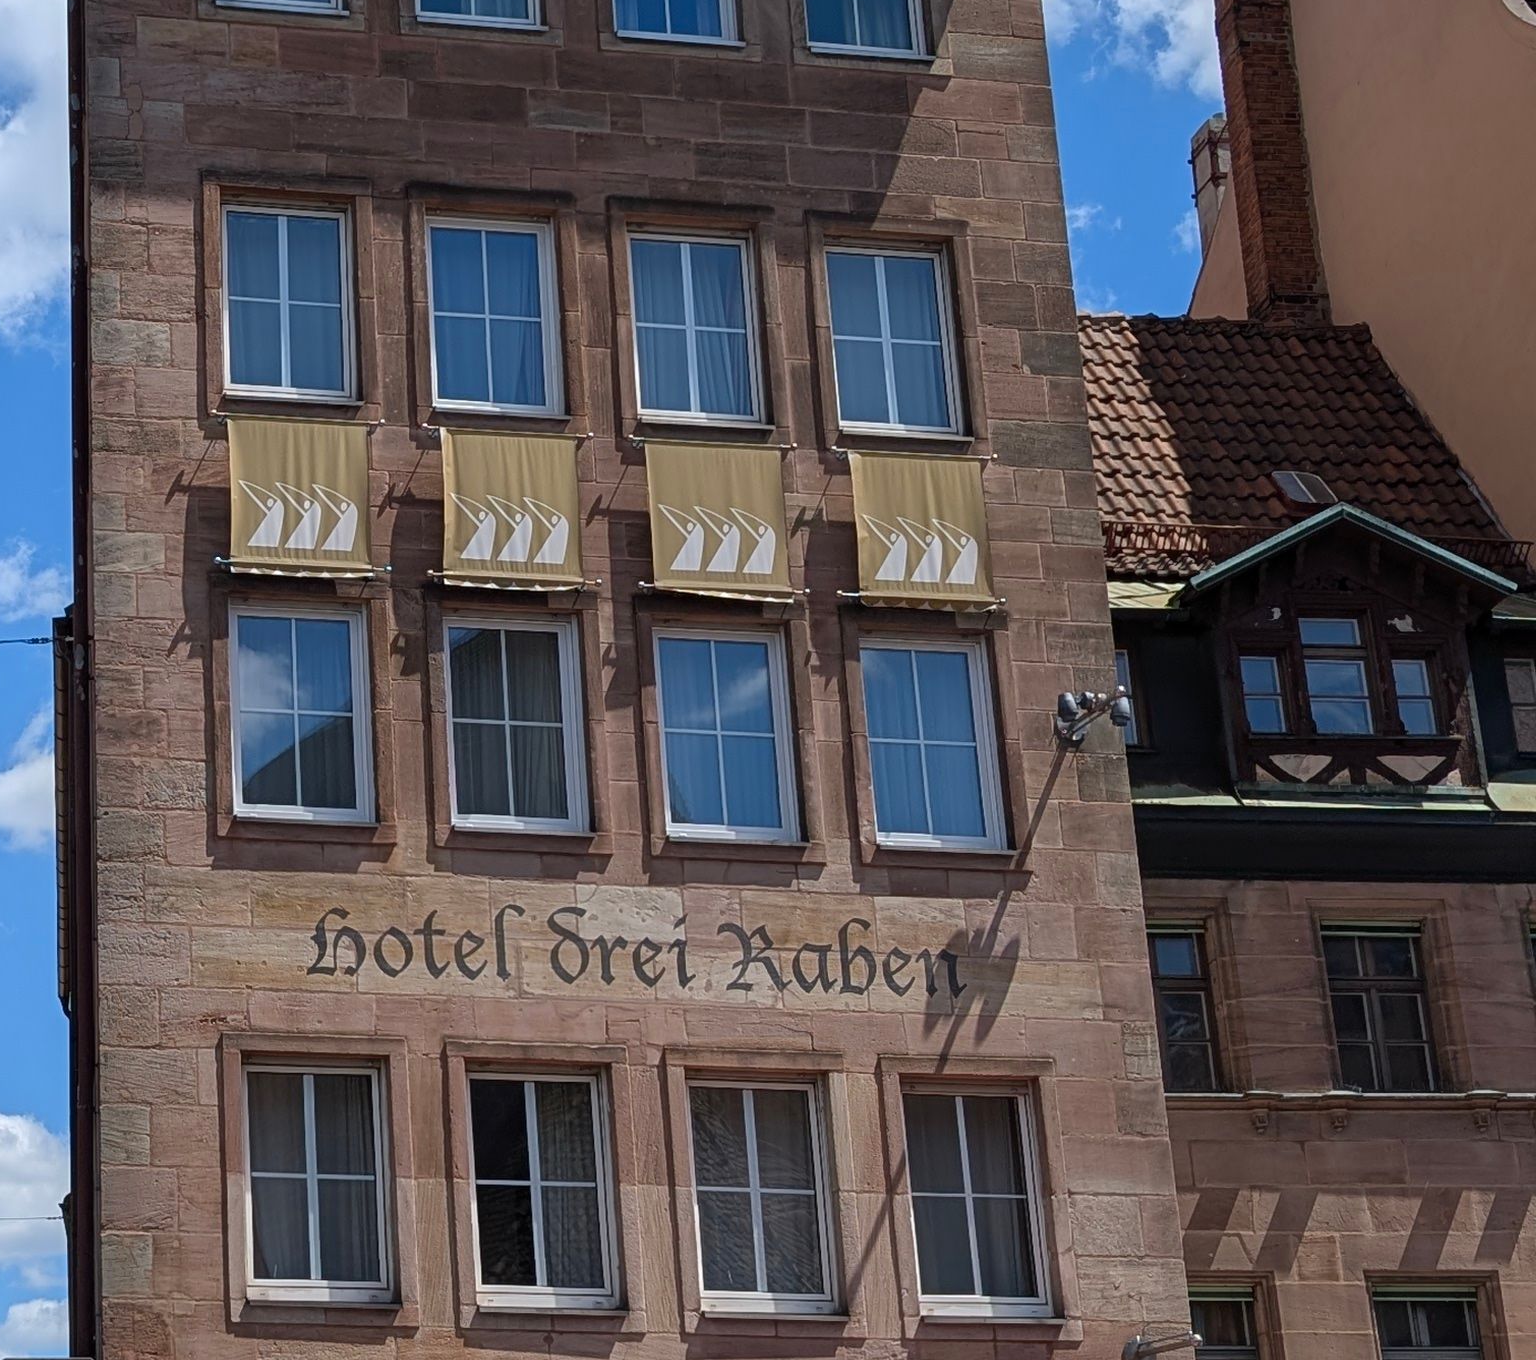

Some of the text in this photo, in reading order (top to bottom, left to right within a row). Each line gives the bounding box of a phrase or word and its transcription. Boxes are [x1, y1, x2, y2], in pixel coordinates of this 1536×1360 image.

[307, 904, 967, 998] Hotel drei Raben
